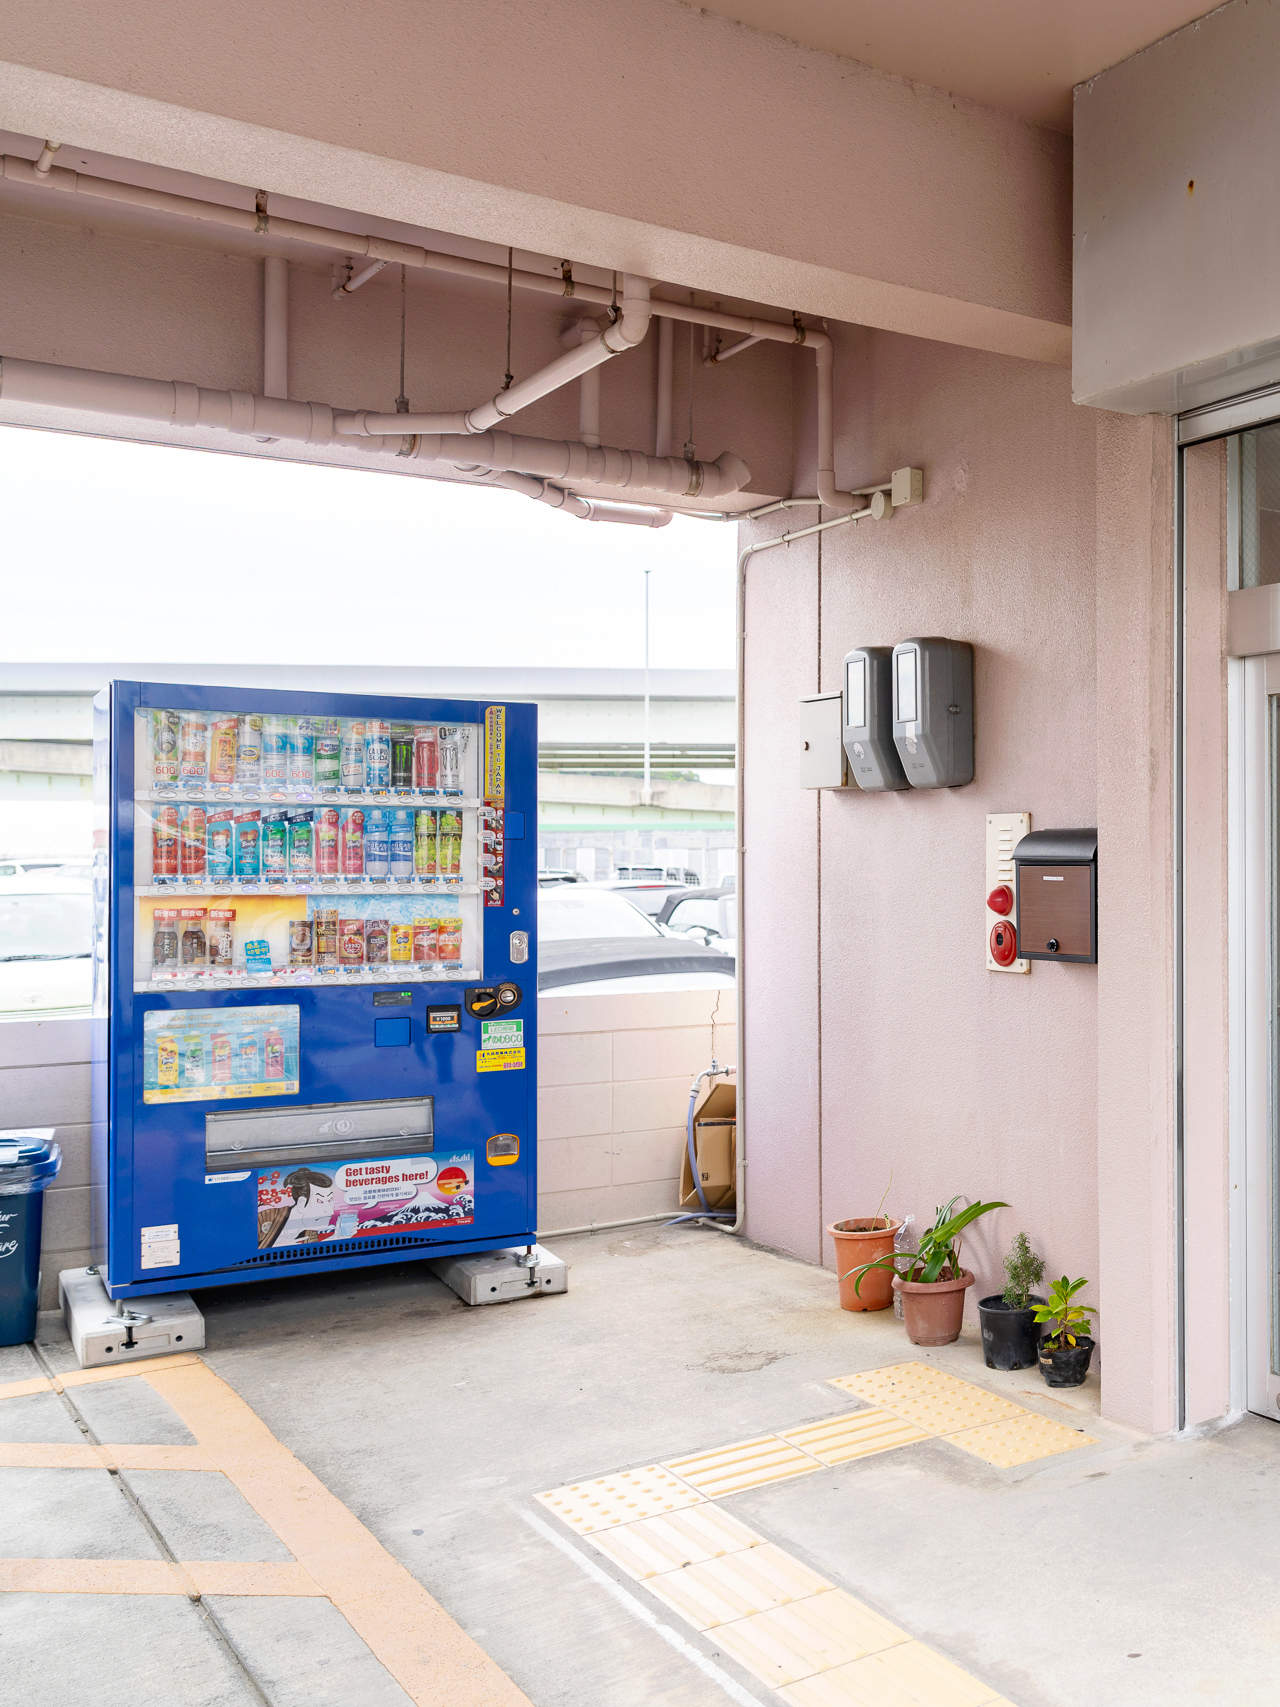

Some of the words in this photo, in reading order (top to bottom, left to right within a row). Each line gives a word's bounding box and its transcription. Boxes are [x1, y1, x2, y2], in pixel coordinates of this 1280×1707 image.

[299, 717, 338, 732] Asahi
[496, 752, 501, 763] TO
[156, 766, 175, 775] 600
[182, 767, 203, 775] 600
[265, 770, 285, 778] 600
[291, 770, 311, 779] 600
[449, 1153, 470, 1163] Asahi
[345, 1167, 364, 1177] Get
[365, 1165, 391, 1176] tasty
[345, 1174, 400, 1188] beverages
[402, 1170, 429, 1182] here!
